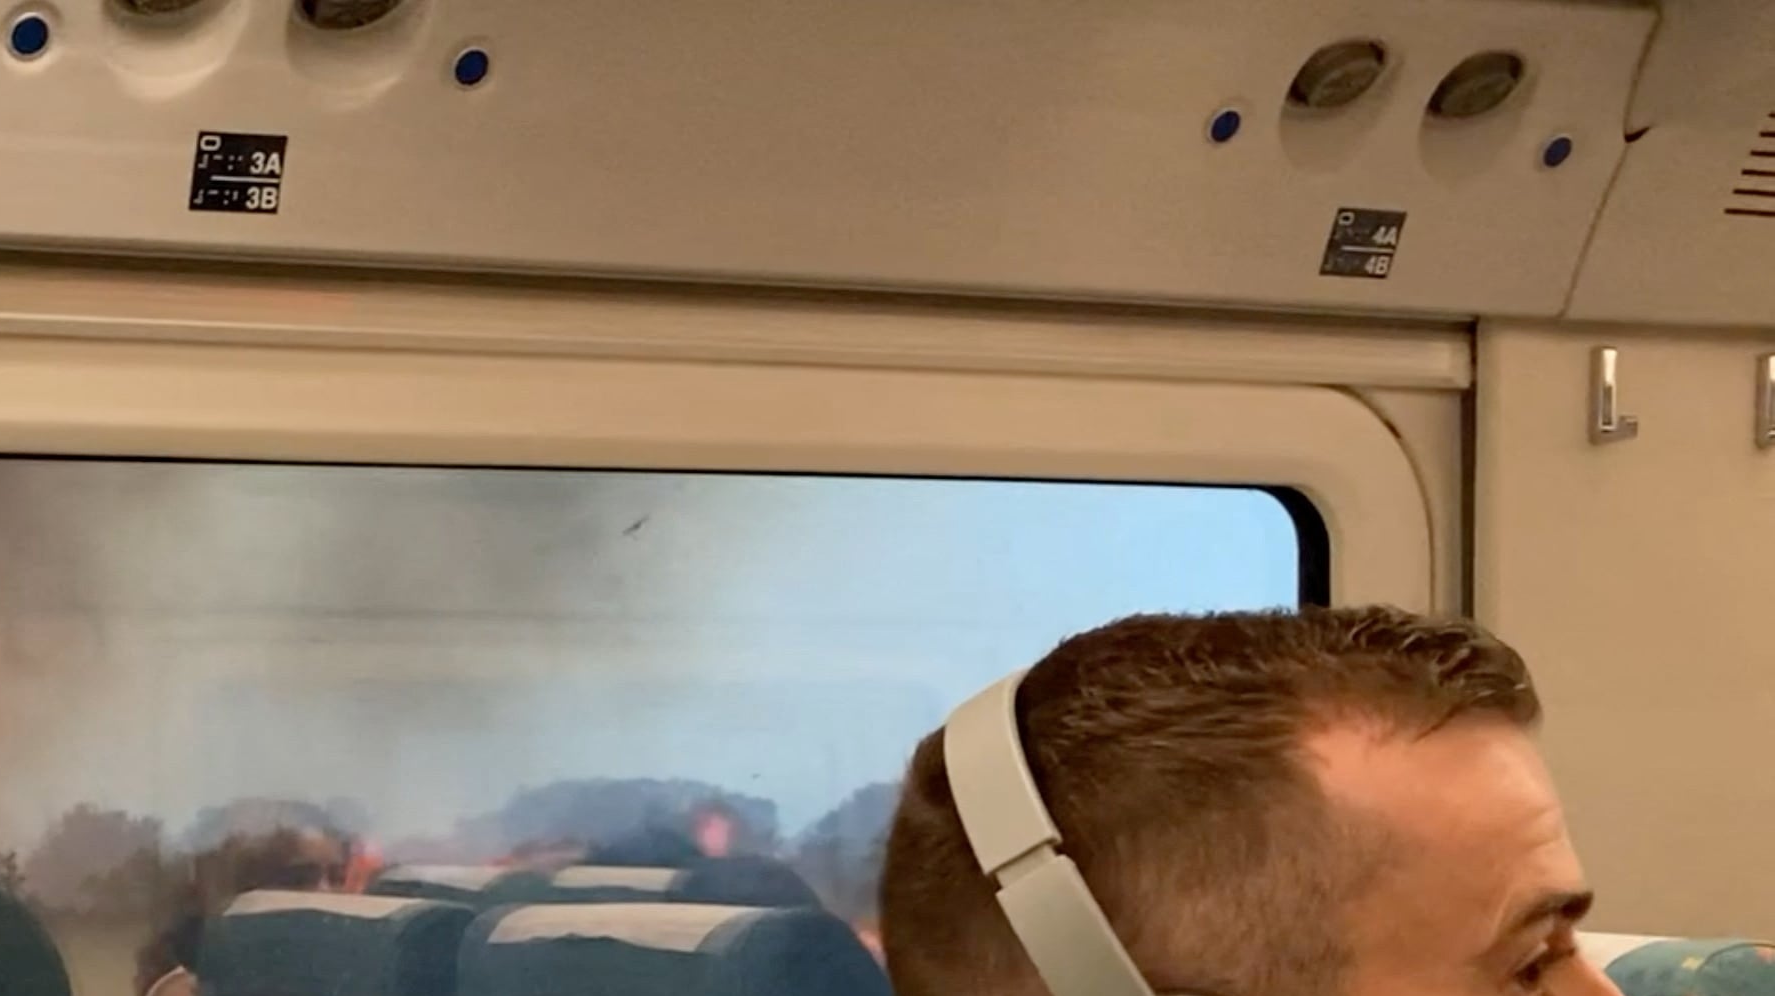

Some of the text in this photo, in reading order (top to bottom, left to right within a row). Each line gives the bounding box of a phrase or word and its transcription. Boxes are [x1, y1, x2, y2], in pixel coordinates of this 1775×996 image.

[250, 151, 281, 175] 3A
[246, 186, 277, 210] 3B
[1372, 225, 1397, 246] 4A
[1365, 255, 1390, 275] 4B
